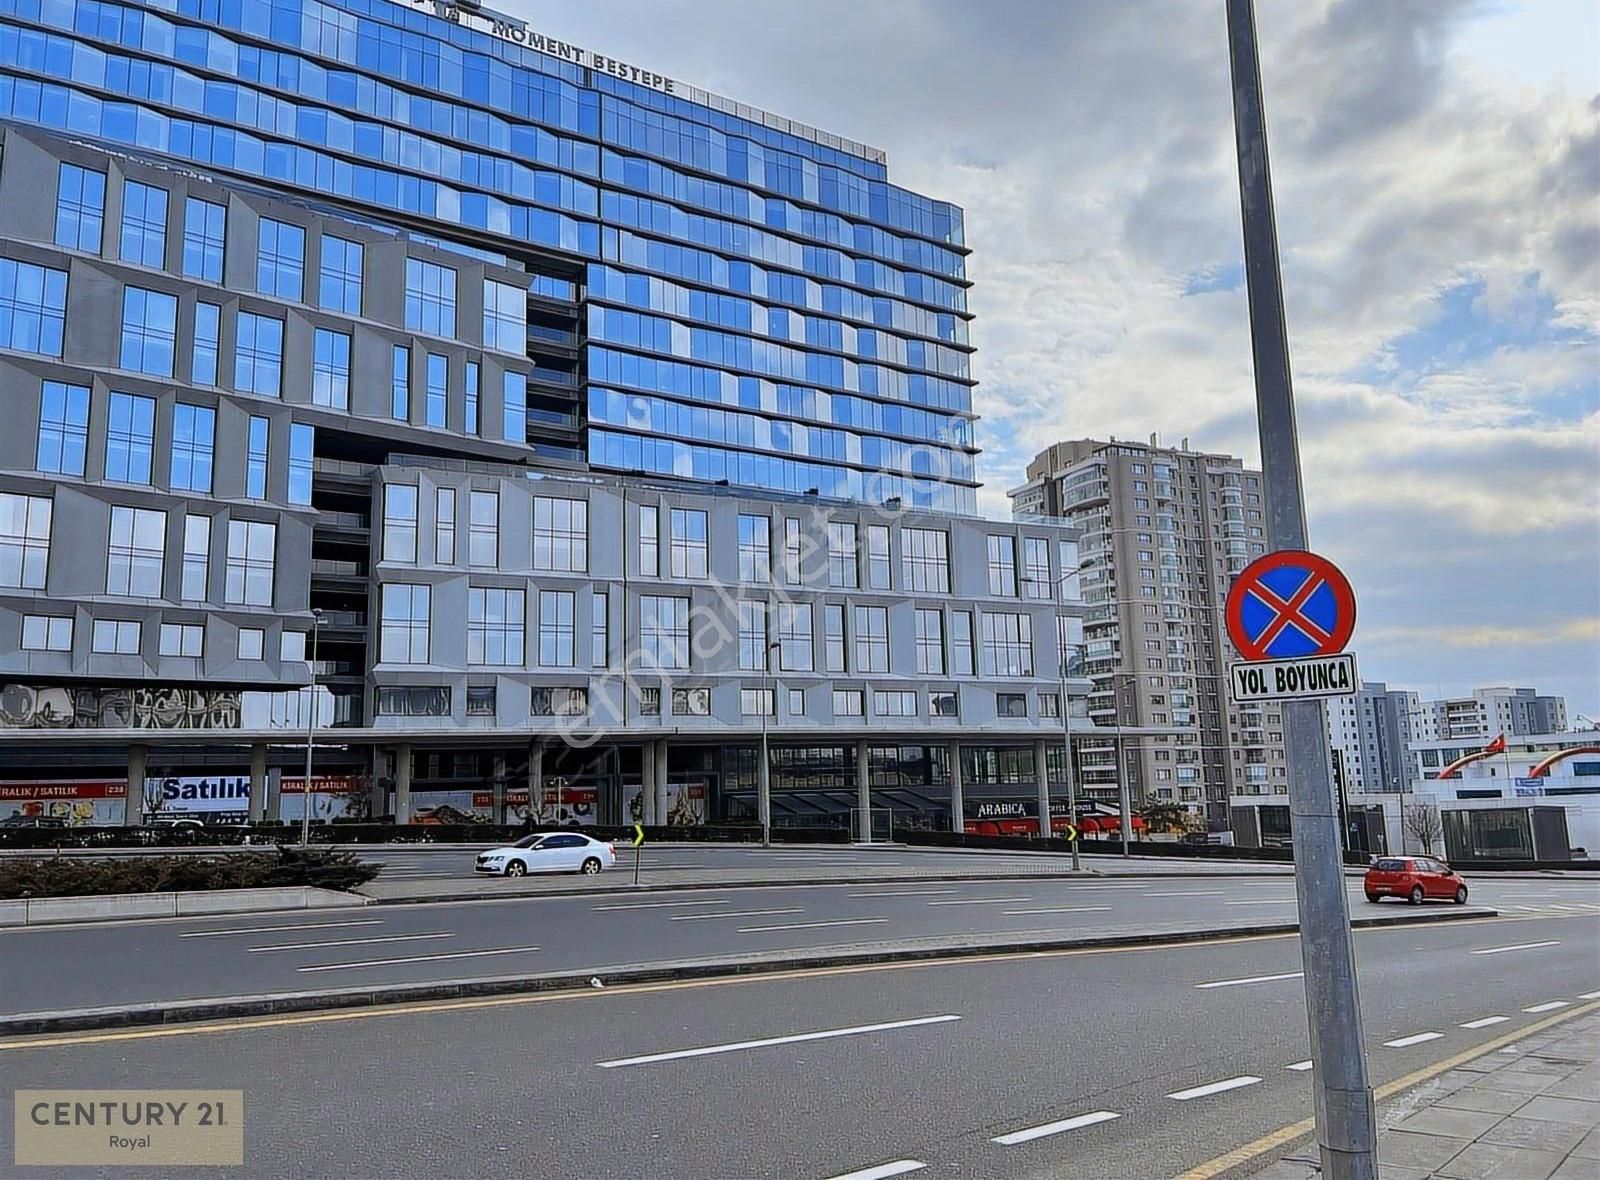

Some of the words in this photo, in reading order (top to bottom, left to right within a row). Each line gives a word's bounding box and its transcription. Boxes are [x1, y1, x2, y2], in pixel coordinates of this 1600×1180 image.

[492, 18, 584, 62] MOMENT
[1238, 669, 1268, 695] YOL
[1275, 661, 1349, 693] BOYUNCA
[978, 803, 1027, 818] ARABICA
